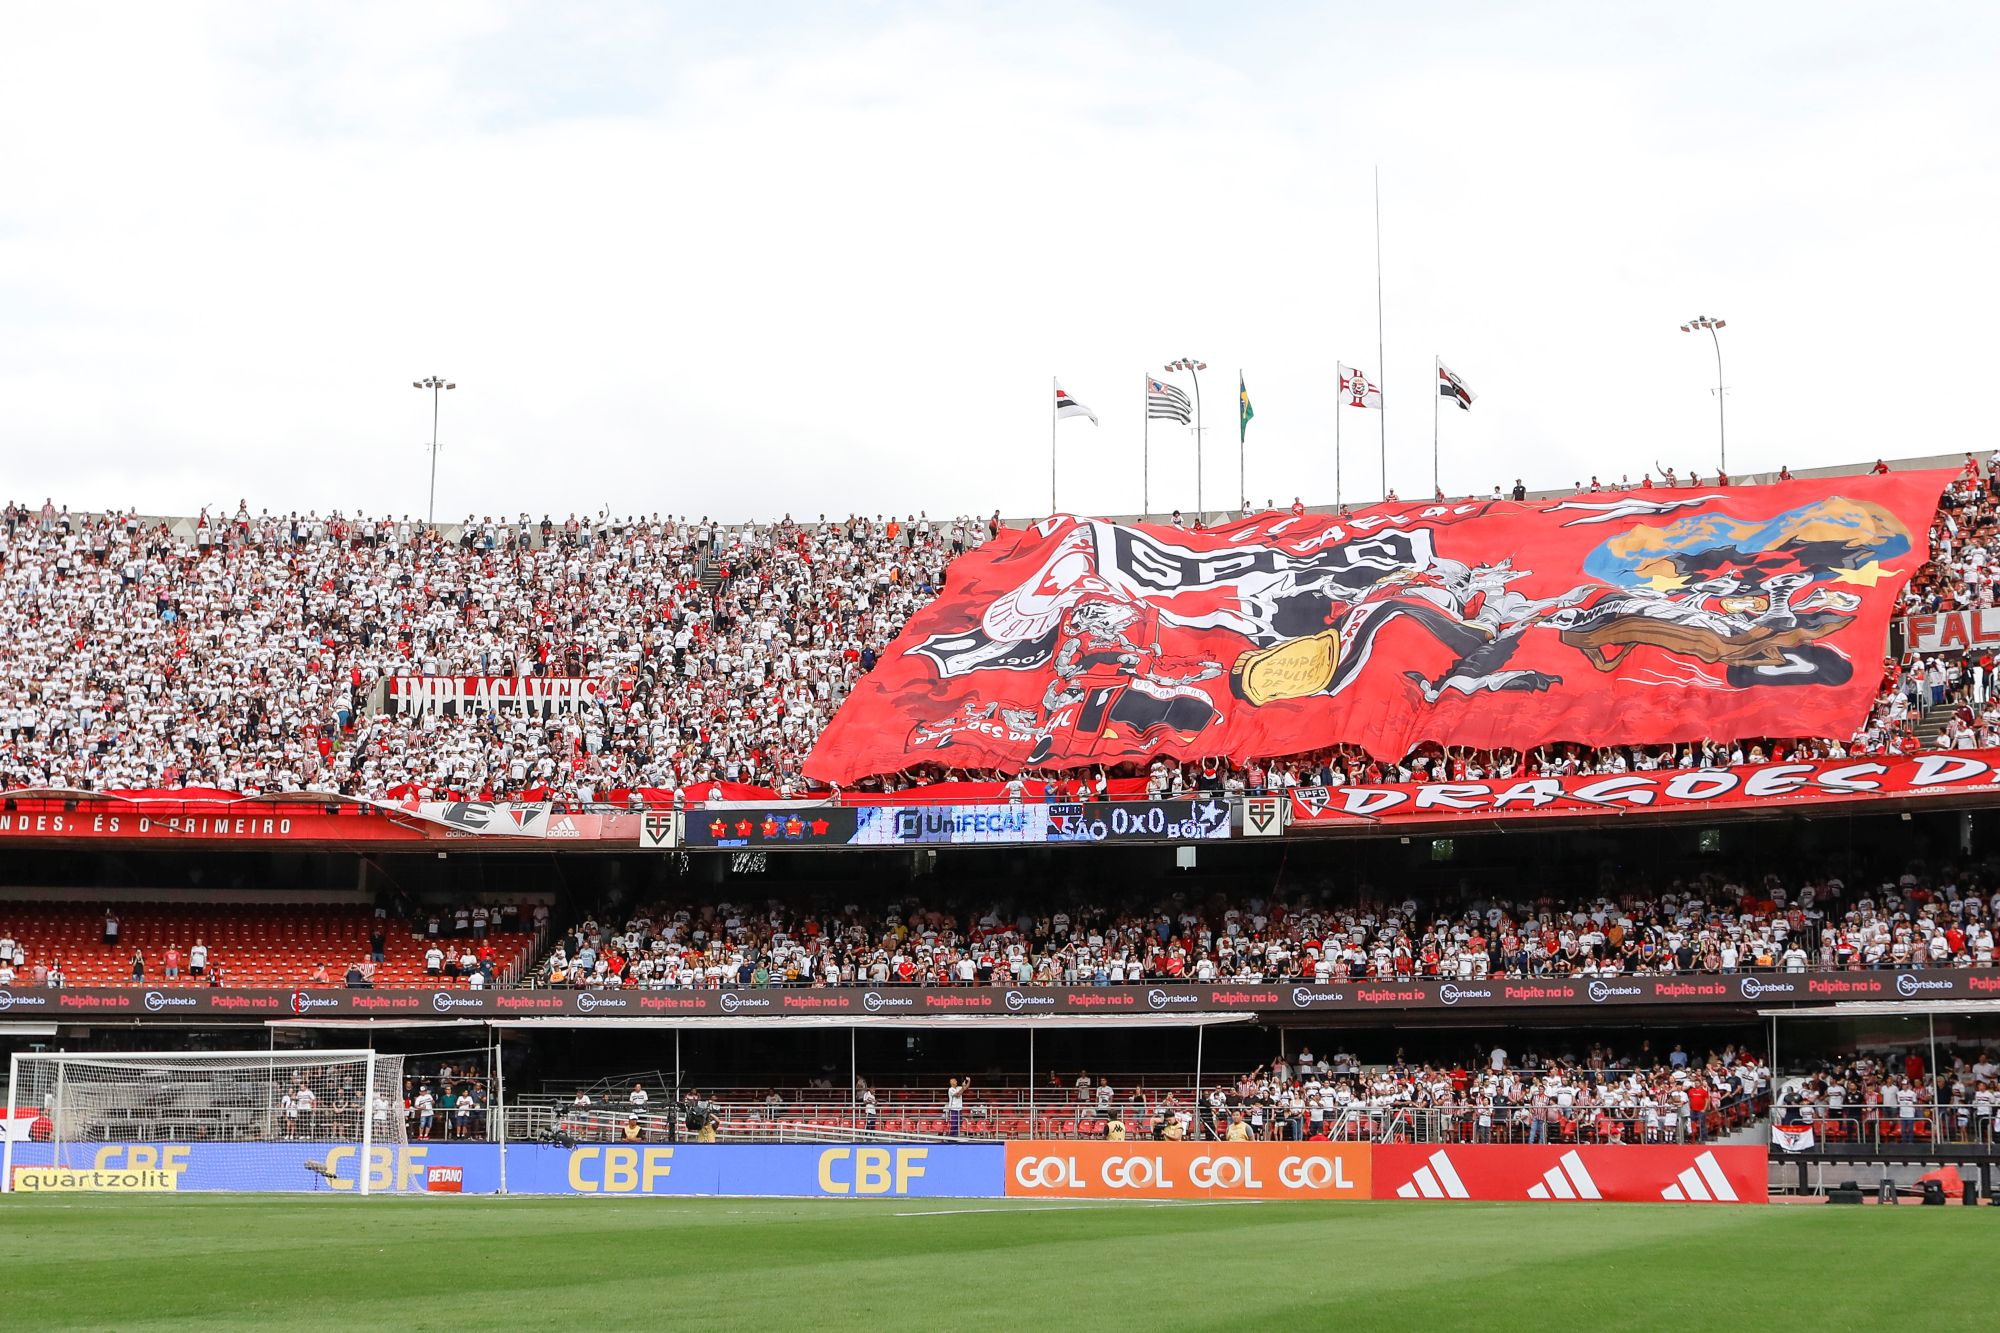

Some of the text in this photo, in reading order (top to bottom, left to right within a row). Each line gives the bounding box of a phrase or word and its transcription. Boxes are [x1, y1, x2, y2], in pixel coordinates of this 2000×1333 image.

[1908, 610, 2000, 648] FAL
[1339, 755, 2000, 814] DRAGÕES D
[1298, 789, 1326, 798] SPFC
[93, 813, 119, 833] ÉS
[139, 816, 150, 833] O
[169, 817, 291, 834] PRIMEIRO
[1112, 807, 1165, 834] 0x0
[547, 829, 580, 838] adidas
[1593, 986, 1641, 996] Sportsbet.io
[1655, 983, 1726, 997] Palpite na io
[1746, 984, 1794, 993] Sportsbet.io
[1809, 979, 1882, 994] Palpite na io
[1901, 980, 1953, 991] Sportsbet.io
[1152, 994, 1198, 1004] Sportsbet.io
[1212, 992, 1279, 1005] Palpite na io
[1297, 992, 1343, 1002] Sportsbet.io
[1357, 989, 1425, 1003] Palpite na io
[1445, 989, 1491, 999] Sportsbet.io
[1504, 987, 1574, 1000] Palpite na io
[60, 995, 130, 1008] Palpite na io
[149, 997, 197, 1006] Sportsbet.io
[211, 996, 279, 1009] Palpite na io
[298, 997, 338, 1007] Sportsbet.io
[352, 997, 419, 1009] Palpite na io
[437, 997, 483, 1007] Sportsbet.io
[497, 997, 563, 1009] Palpite na io
[581, 998, 626, 1007] Sportsbet.io
[640, 998, 706, 1010] Palpite na io
[724, 998, 769, 1008] Sportsbet.io
[784, 997, 849, 1009] Palpite na io
[868, 997, 913, 1007] Sportsbet.io
[927, 995, 992, 1008] Palpite na io
[1010, 996, 1055, 1005] Sportsbet.io
[1068, 995, 1134, 1007] Palpite na io
[326, 1146, 428, 1191] CBF
[568, 1147, 674, 1193] CBF
[818, 1148, 928, 1194] CBF
[1015, 1156, 1086, 1189] GOL
[1101, 1156, 1173, 1189] GOL
[1188, 1156, 1263, 1189] GOL
[1278, 1156, 1354, 1189] GOL
[22, 1170, 169, 1190] quartzolit
[428, 1168, 462, 1183] BETANO
